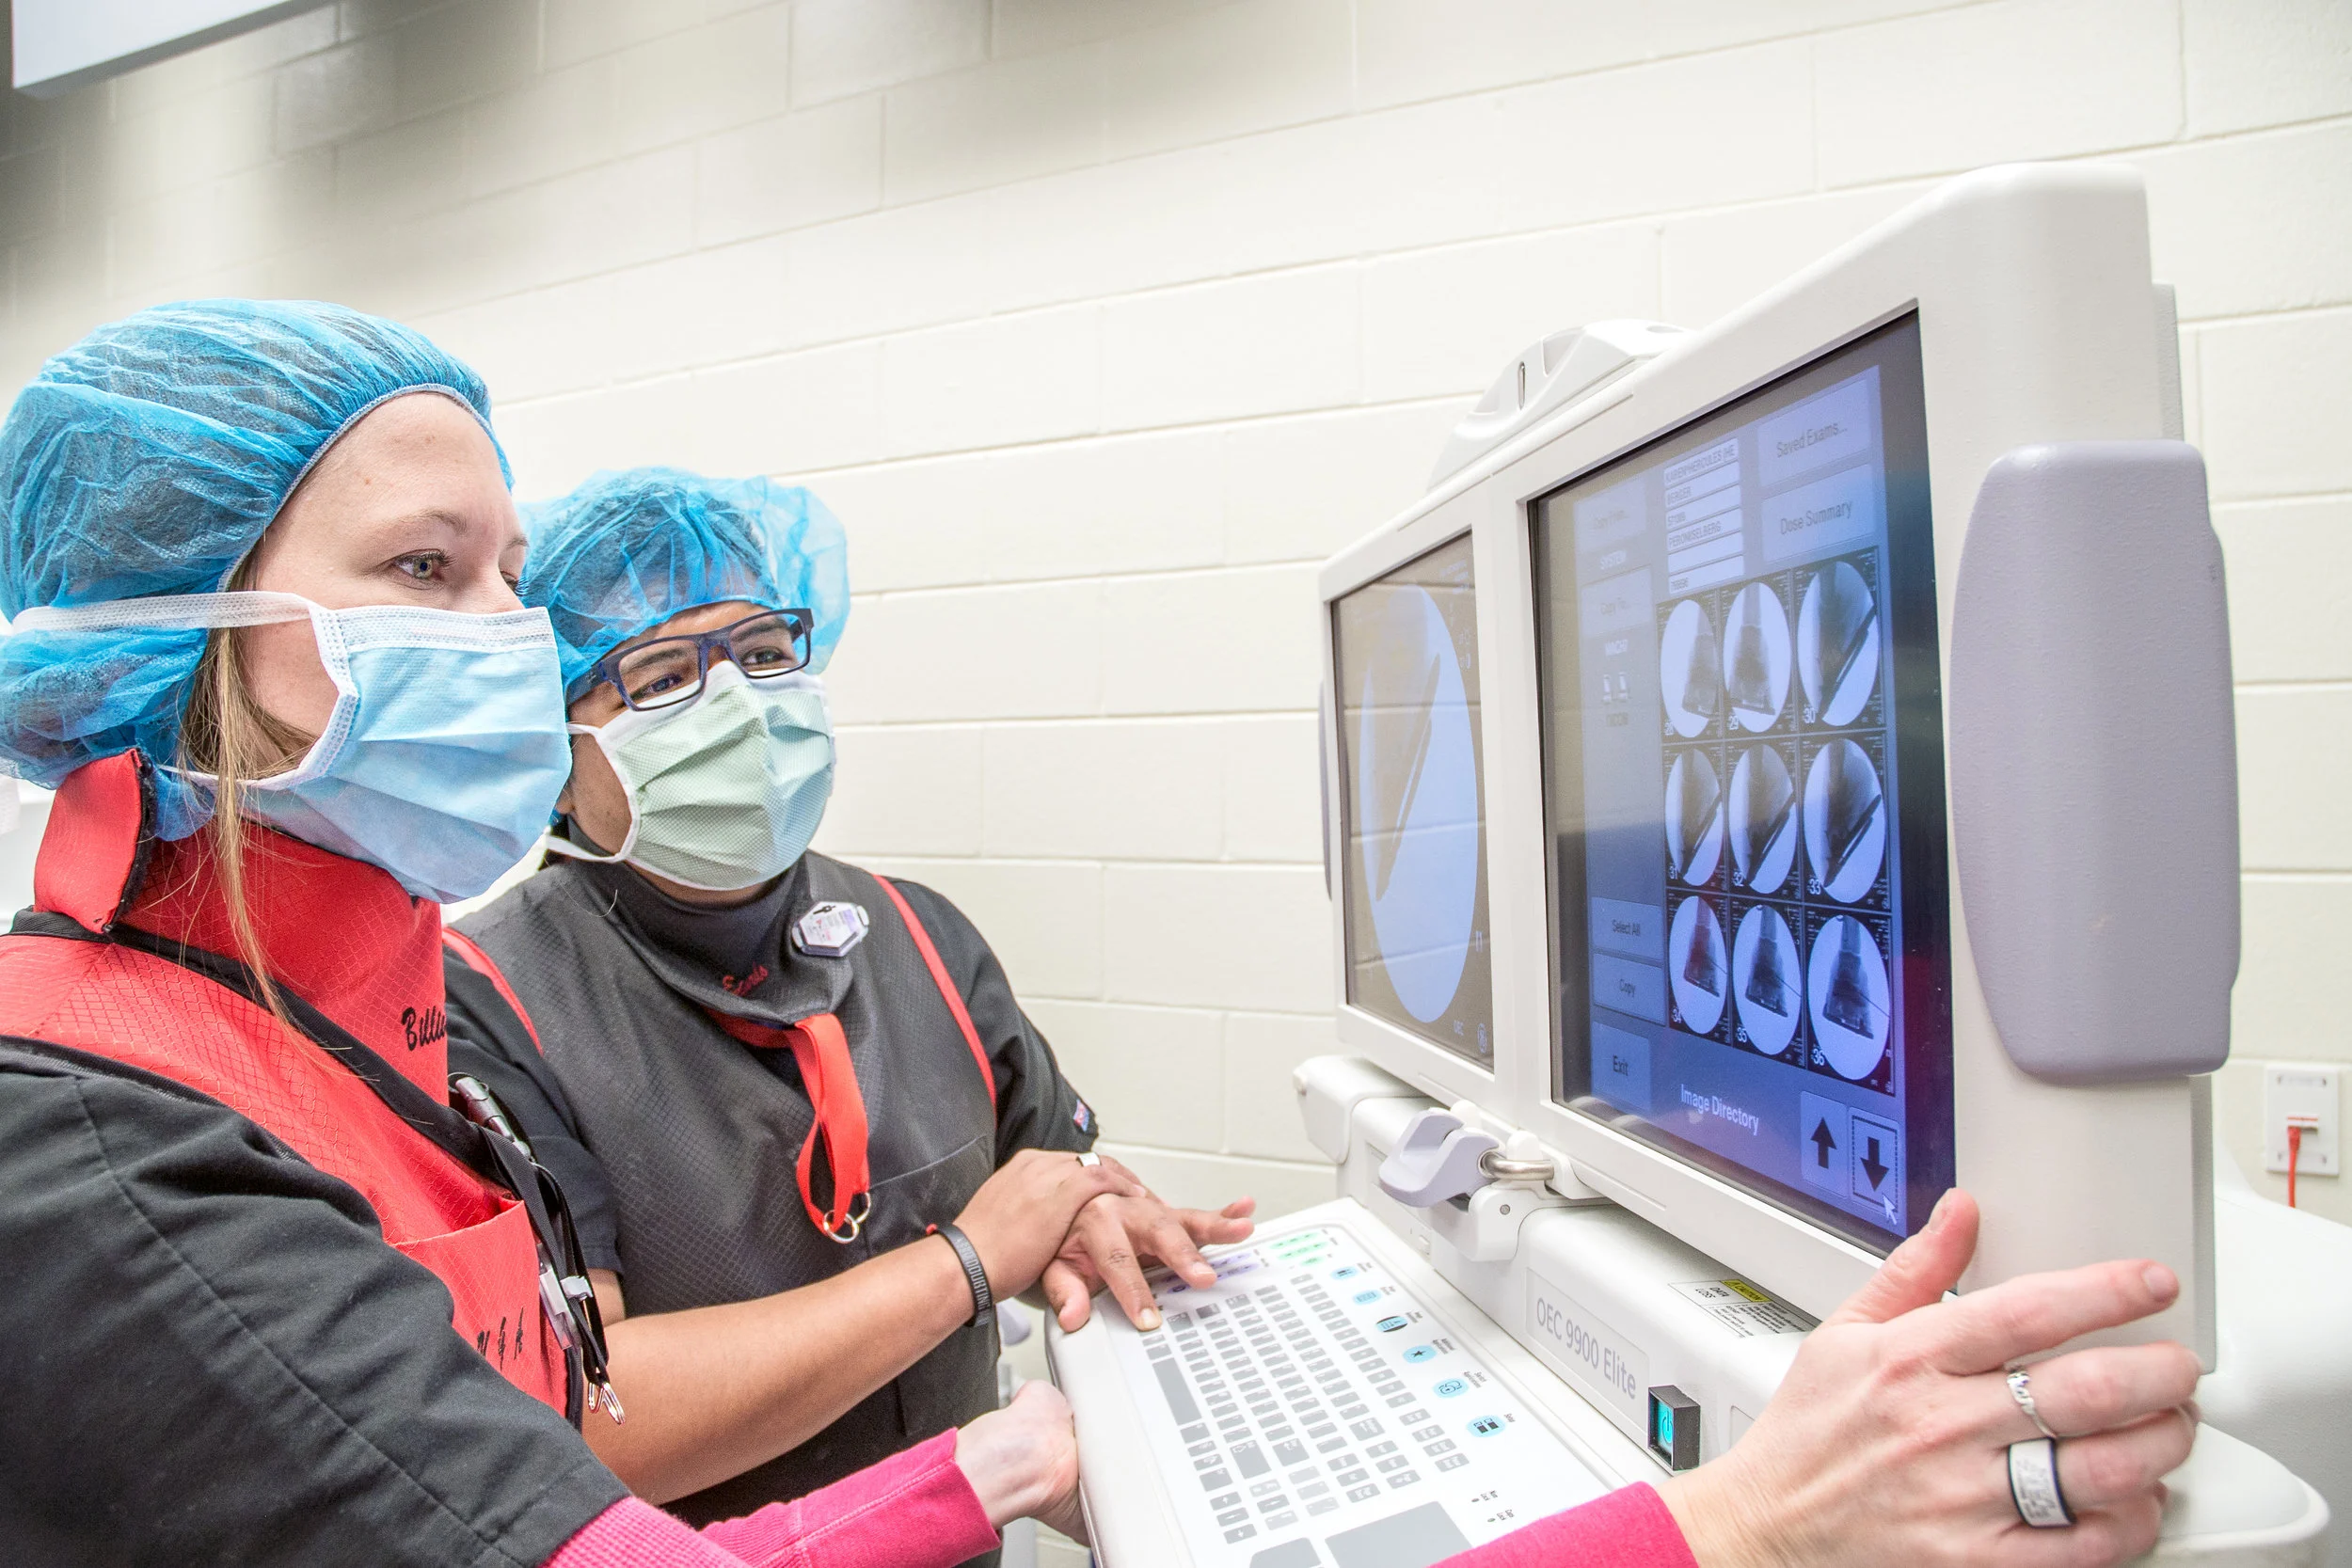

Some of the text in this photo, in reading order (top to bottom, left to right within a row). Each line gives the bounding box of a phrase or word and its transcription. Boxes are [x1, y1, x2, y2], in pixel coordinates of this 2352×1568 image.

[1776, 422, 1848, 458] Saved Exams...
[1780, 499, 1852, 535] Dose Summary
[1804, 706, 1817, 724] 30
[1808, 878, 1822, 895] 33
[1612, 918, 1641, 937] Select All
[1736, 1026, 1748, 1044] 35
[1613, 1054, 1629, 1077] Exit
[1811, 1046, 1826, 1068] 36
[1680, 1084, 1759, 1136] Image Directory
[1536, 1297, 1636, 1401] OEC 9900 Elite
